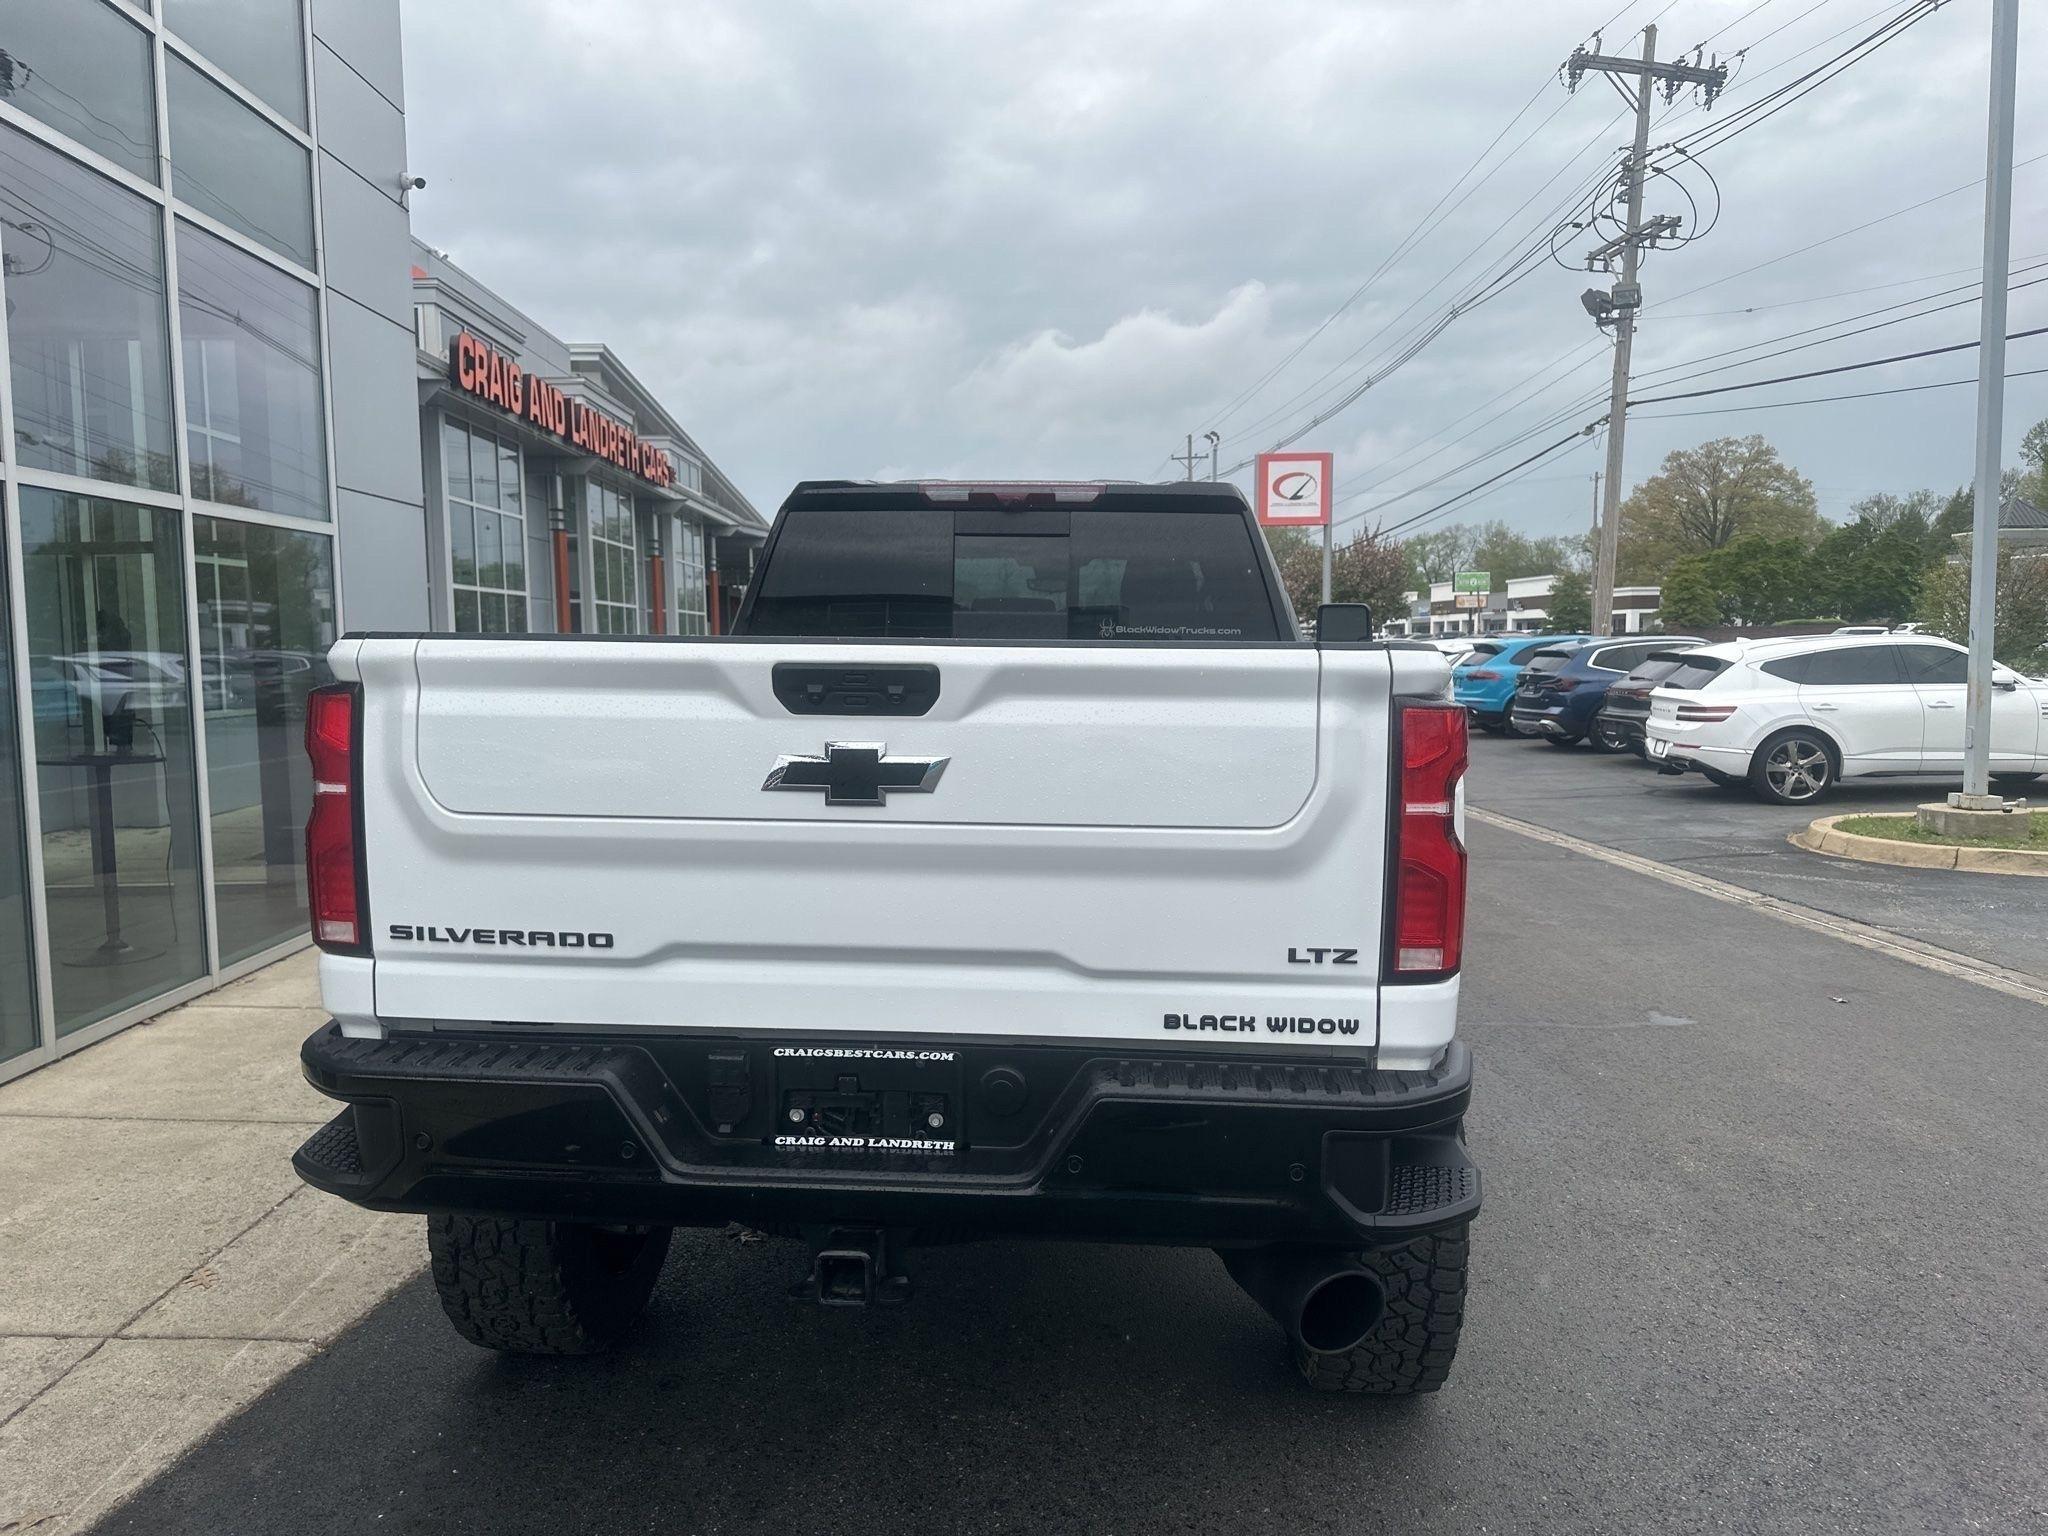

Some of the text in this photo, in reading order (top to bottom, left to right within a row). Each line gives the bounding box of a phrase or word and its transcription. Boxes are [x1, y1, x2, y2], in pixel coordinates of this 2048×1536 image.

[457, 331, 669, 488] CRAIG AND LANDRETH CARS
[1115, 624, 1242, 635] BlackWidowTrucks.com
[389, 924, 614, 948] SILVERADO
[1287, 947, 1358, 964] LTZ
[1163, 1013, 1360, 1035] BLACK WIDOW
[773, 1048, 955, 1061] CRAIGSBESTCARS.COM
[774, 1136, 956, 1150] CRAIG AND LANDRETH
